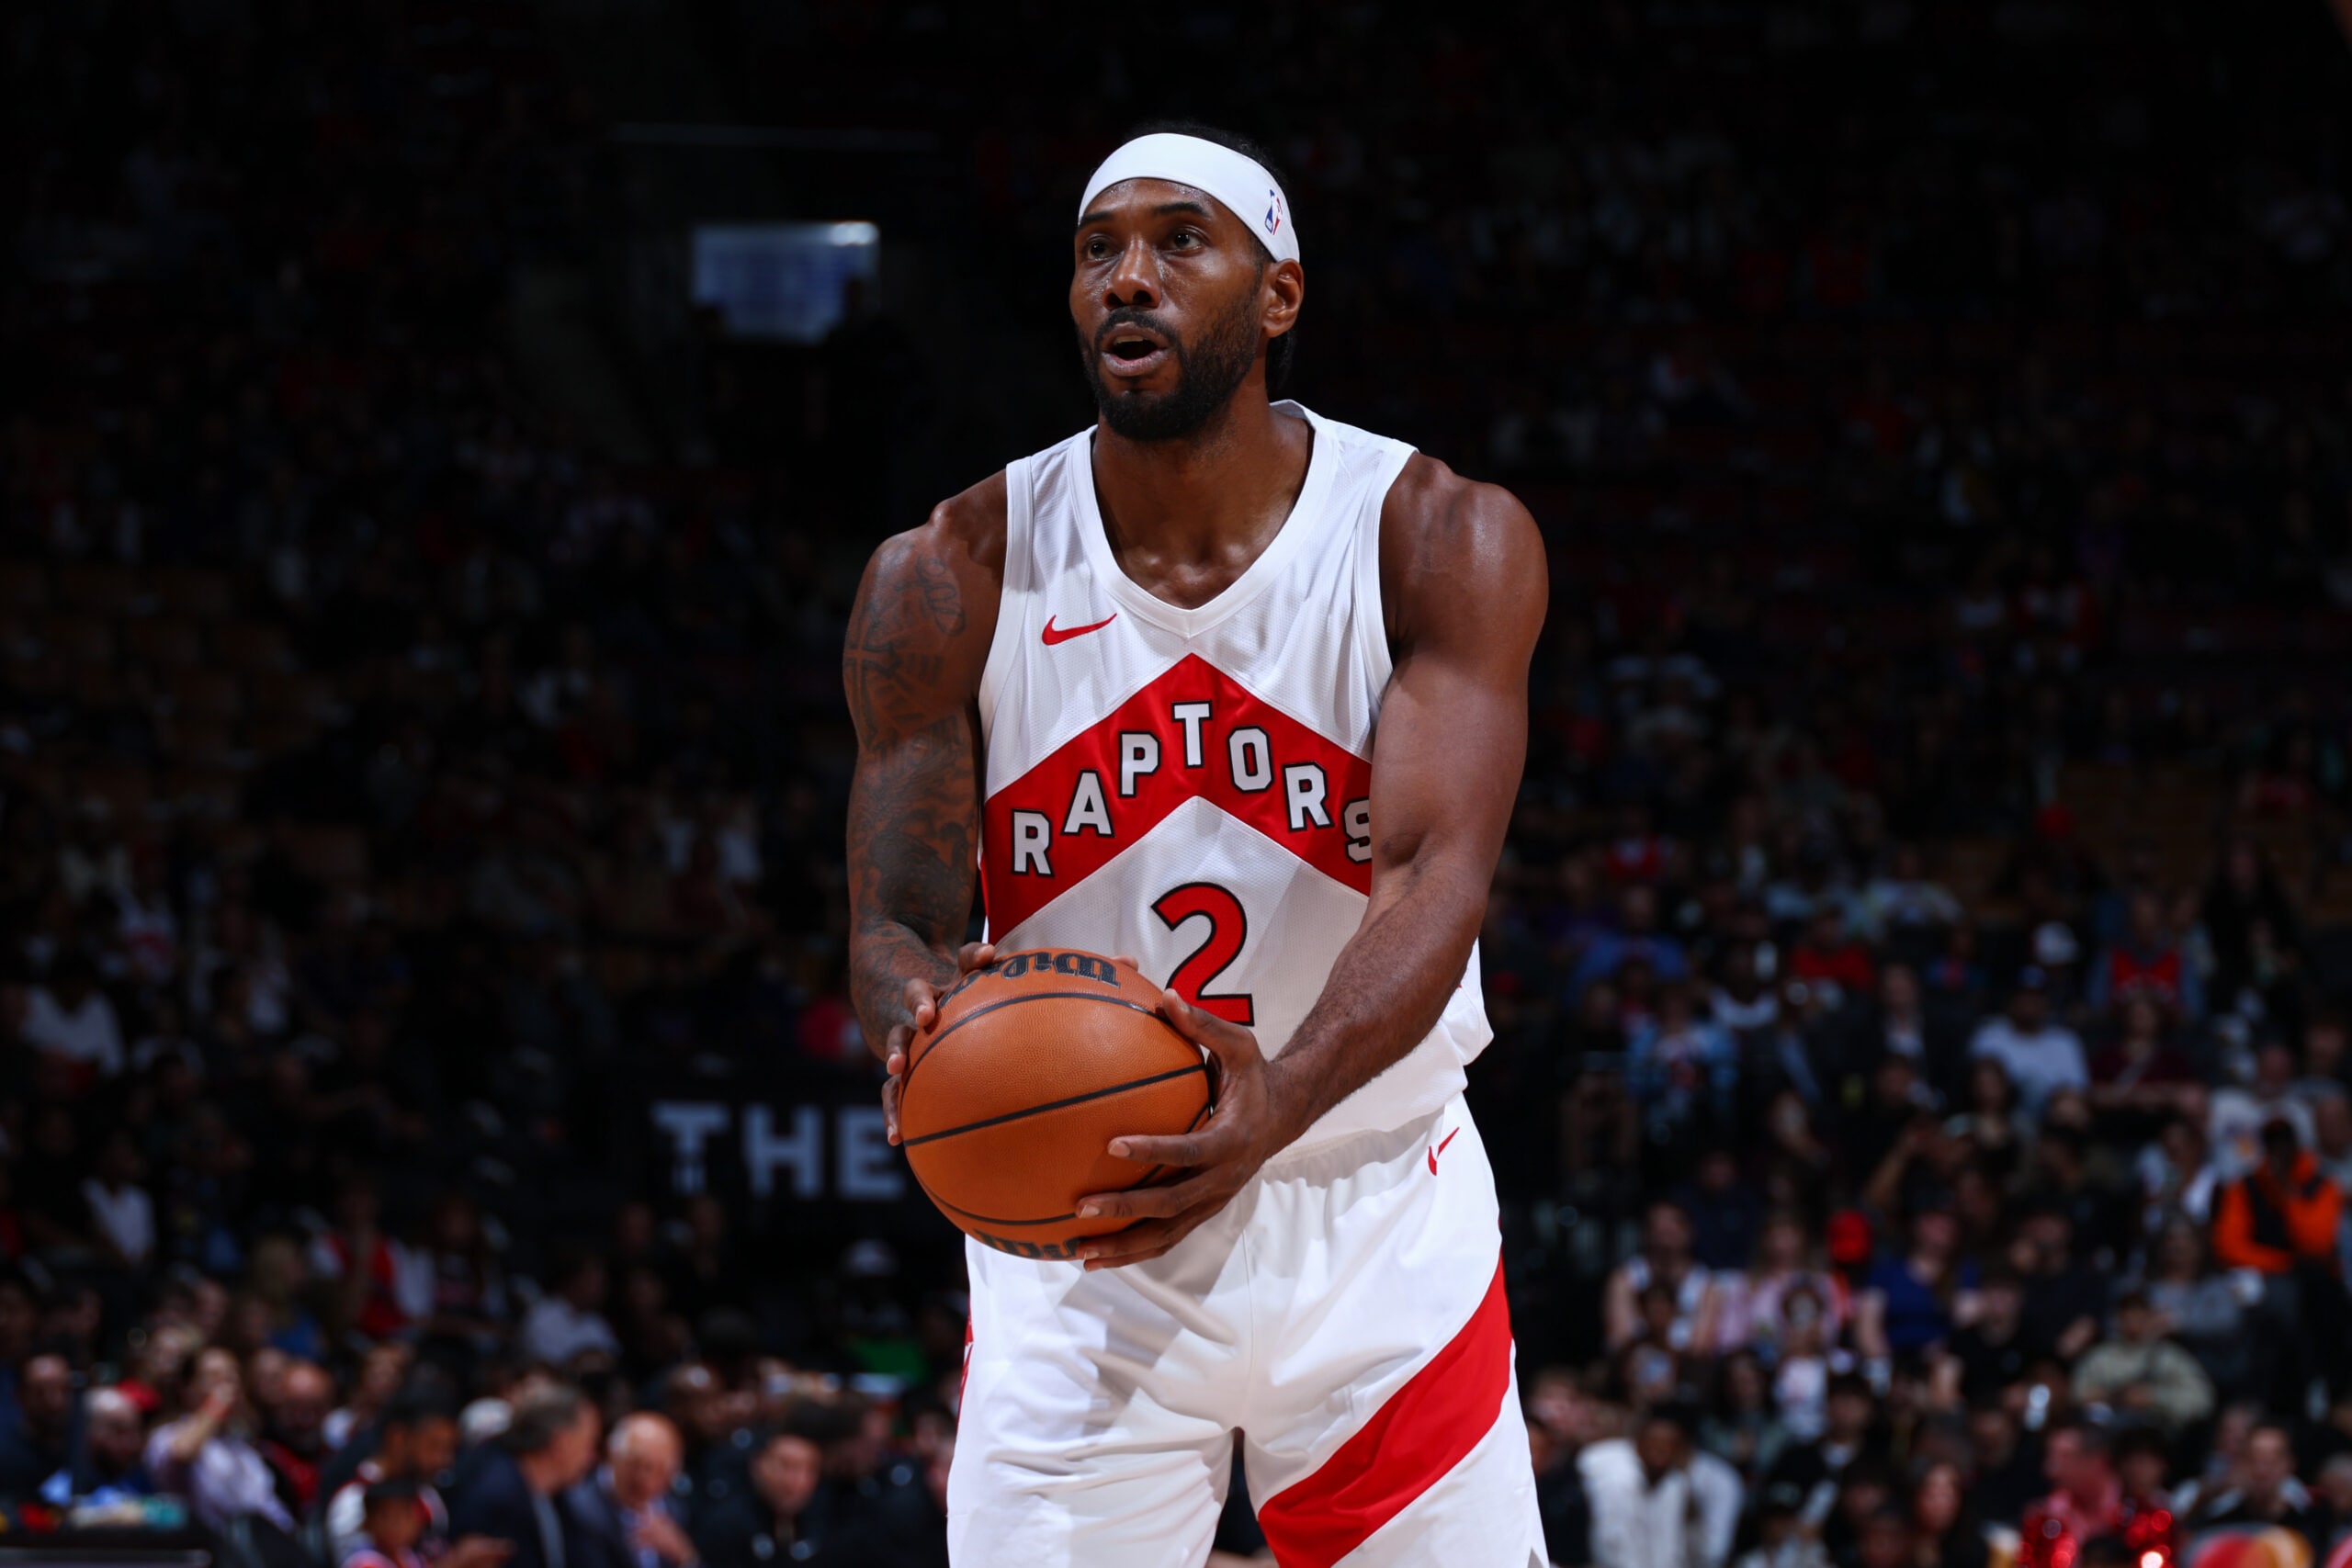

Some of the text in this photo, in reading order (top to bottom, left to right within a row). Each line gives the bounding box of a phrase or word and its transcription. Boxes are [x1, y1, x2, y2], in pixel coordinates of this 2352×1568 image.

[1012, 701, 1372, 877] RAPTORS
[1151, 882, 1254, 1026] 2
[650, 1102, 905, 1198] THE
